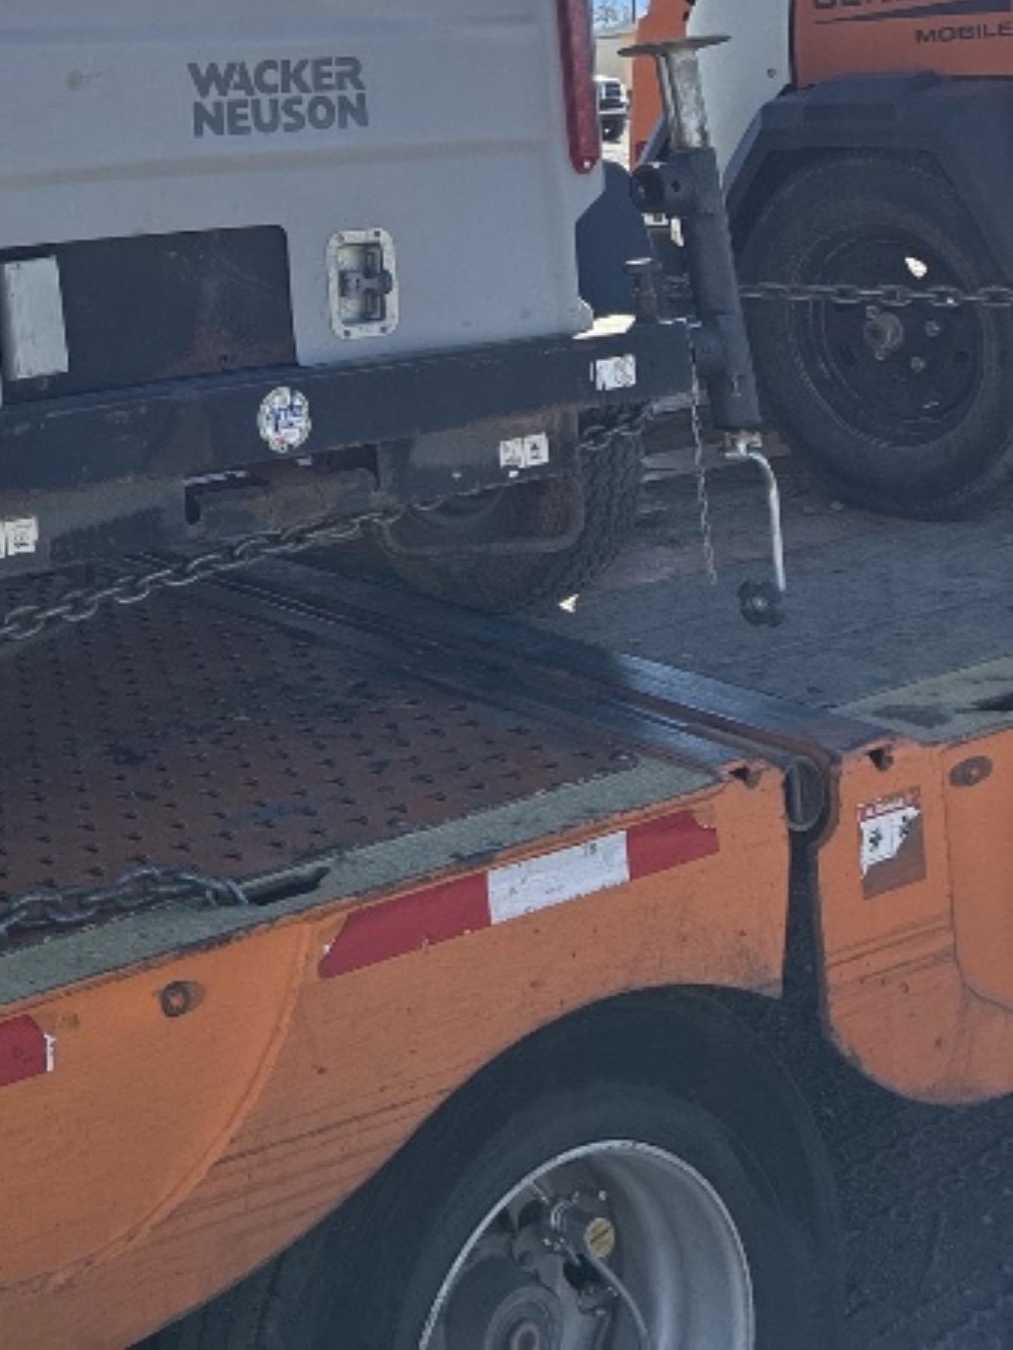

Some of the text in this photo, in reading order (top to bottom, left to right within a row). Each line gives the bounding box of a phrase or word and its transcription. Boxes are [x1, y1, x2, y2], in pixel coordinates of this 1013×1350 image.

[915, 21, 1013, 45] MOBILE
[187, 56, 365, 99] WACKER
[193, 92, 369, 138] NEUSON
